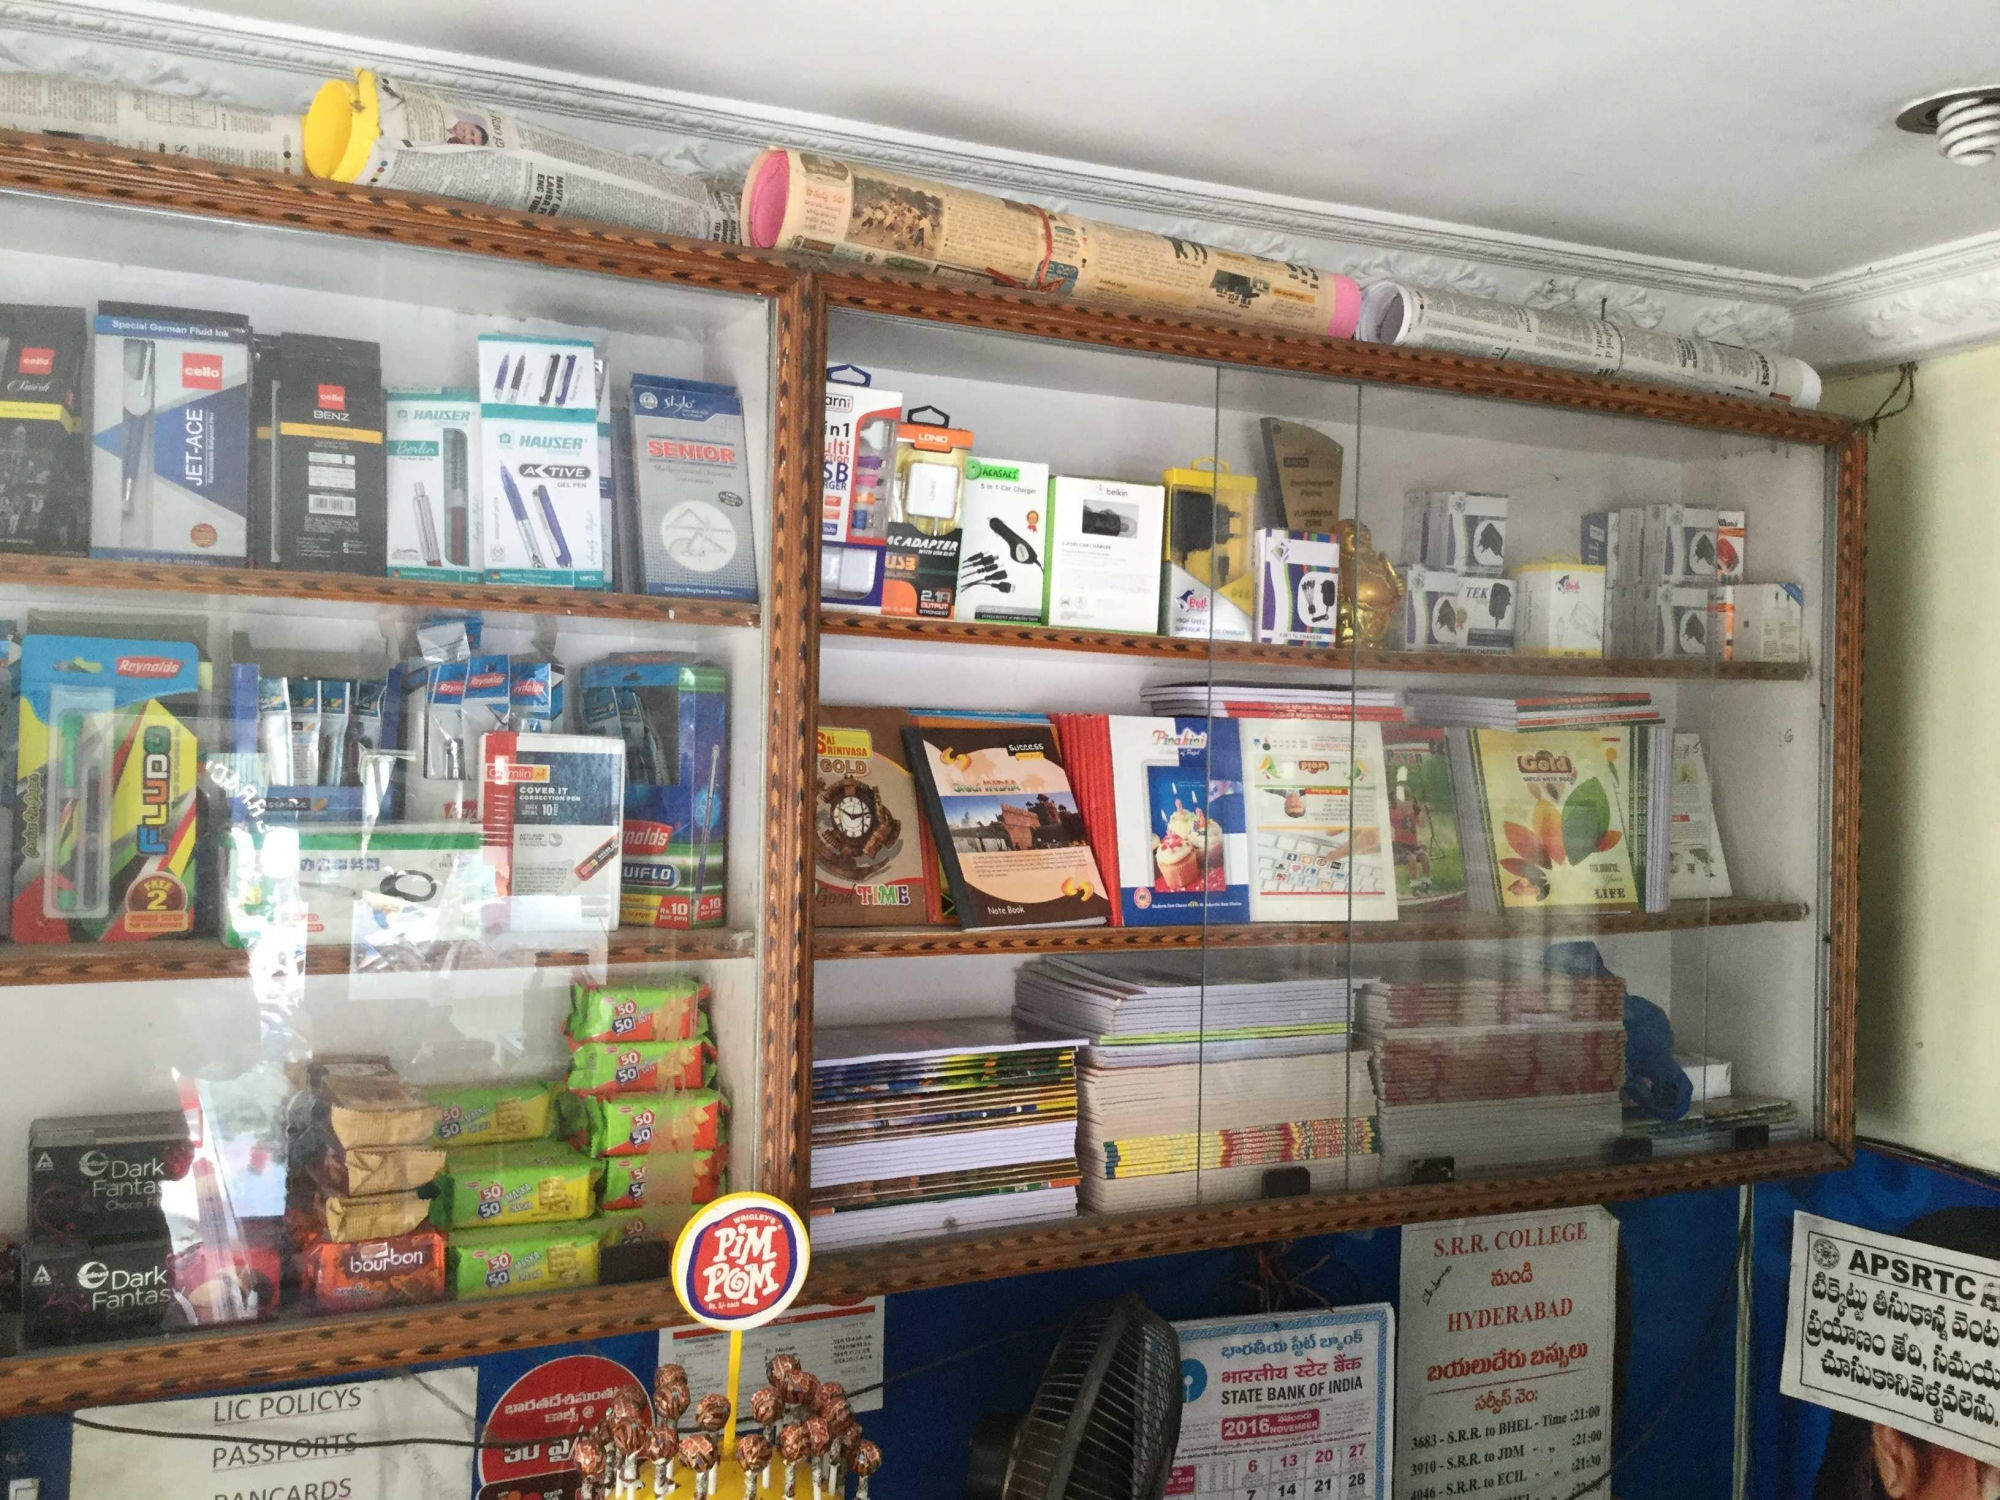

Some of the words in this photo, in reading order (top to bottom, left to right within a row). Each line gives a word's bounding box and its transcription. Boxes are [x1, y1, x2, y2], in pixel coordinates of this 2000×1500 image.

[112, 319, 148, 330] Special
[150, 323, 187, 334] German
[190, 326, 213, 336] Fluid
[215, 330, 230, 338] Ink
[184, 366, 220, 378] cello
[320, 394, 344, 402] cello
[313, 410, 350, 422] BENZ
[412, 410, 470, 421] HAUSER
[185, 408, 203, 487] JET-ACE
[518, 435, 583, 450] HAUSER
[648, 440, 736, 464] SENIOR
[1013, 486, 1037, 495] Charger
[1106, 488, 1128, 497] belkin
[901, 536, 959, 552] ADAPTER
[118, 660, 181, 674] Reynolds
[1152, 728, 1208, 749] Pinakini
[820, 758, 867, 775] GOLD
[1520, 752, 1571, 772] Gold
[137, 725, 172, 856] FLUDO
[520, 786, 556, 794] COVER
[542, 804, 553, 816] 10
[144, 880, 173, 892] FREE
[1594, 888, 1625, 899] LIFE
[146, 890, 168, 910] 2
[856, 884, 911, 906] TIME
[671, 902, 688, 915] 10
[709, 898, 721, 910] 10
[988, 906, 1006, 915] Note
[1007, 904, 1026, 914] Book
[616, 1002, 635, 1016] 50
[615, 1018, 636, 1033] 50
[620, 1052, 640, 1066] 50
[617, 1068, 638, 1083] 50
[442, 1106, 462, 1122] 50
[634, 1112, 652, 1126] 50
[438, 1122, 460, 1136] 50
[632, 1128, 651, 1144] 50
[112, 1158, 165, 1179] Dark
[482, 1186, 502, 1199] 50
[505, 1184, 532, 1202] MASKA
[480, 1202, 500, 1218] 50
[732, 1212, 778, 1225] WRIGLEY'S
[1434, 1234, 1489, 1258] S.R.R.
[1494, 1222, 1588, 1250] COLLEGE
[350, 1248, 424, 1274] bourbon
[490, 1254, 509, 1269] 50
[112, 1265, 168, 1290] Dark
[488, 1272, 508, 1287] 50
[1490, 1261, 1534, 1288] నుండి
[1848, 1248, 1978, 1301] APSRTC
[703, 1260, 780, 1307] POM
[1447, 1298, 1574, 1334] HYDERABAD
[1221, 1339, 1288, 1360] భారతీయ
[1221, 1362, 1288, 1384] भारतीय
[1294, 1356, 1329, 1378] स्टेट
[1334, 1354, 1363, 1373] बैंक
[1221, 1388, 1262, 1405] STATE
[1267, 1383, 1306, 1401] BANK
[1310, 1381, 1325, 1398] OF
[1328, 1376, 1364, 1395] INDIA
[214, 1400, 251, 1423] LIC
[260, 1386, 362, 1418] POLICYS
[1224, 1418, 1270, 1436] 2016
[1270, 1420, 1319, 1434] NOVEMBER
[1485, 1427, 1496, 1437] to
[1499, 1418, 1533, 1435] BHEL
[1542, 1413, 1568, 1428] Time
[212, 1432, 358, 1469] PASSPORTS
[1248, 1459, 1258, 1473] 6
[1280, 1454, 1298, 1468] 13
[1314, 1450, 1334, 1464] 20
[1349, 1442, 1366, 1457] 27
[1410, 1460, 1437, 1478] 3910
[1484, 1452, 1496, 1463] to
[1497, 1444, 1525, 1461] JDM
[1246, 1489, 1256, 1500] 7
[1278, 1483, 1296, 1496] 14
[1314, 1478, 1332, 1492] 21
[1348, 1472, 1366, 1487] 28
[1484, 1478, 1494, 1488] to
[1497, 1470, 1528, 1486] ECIL
